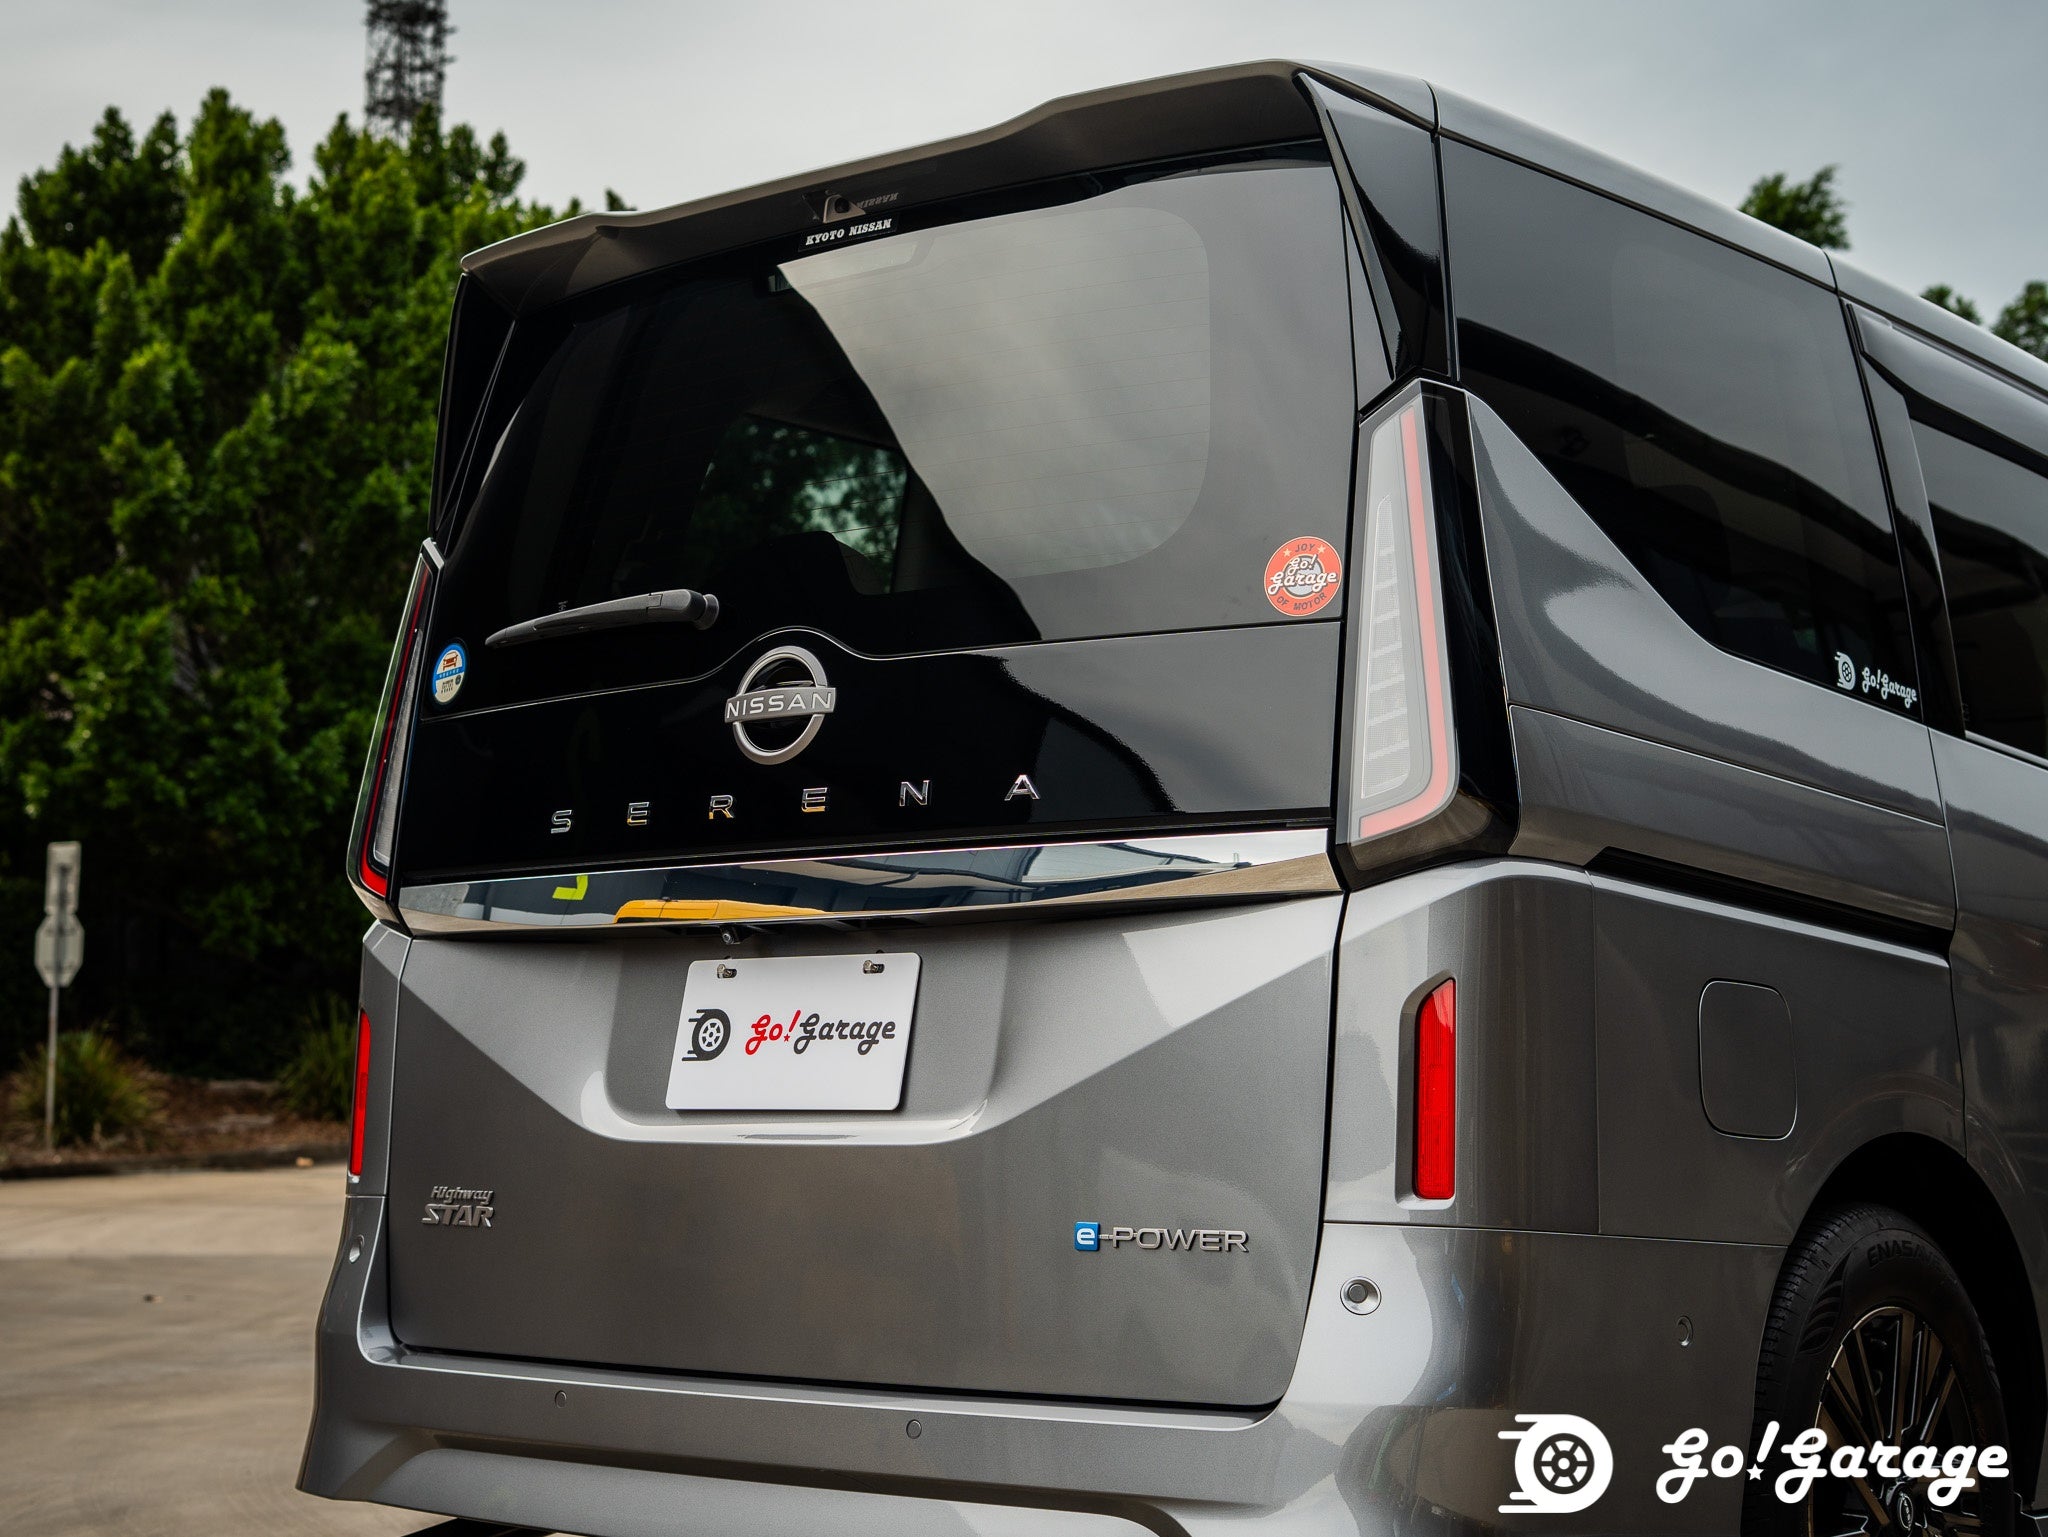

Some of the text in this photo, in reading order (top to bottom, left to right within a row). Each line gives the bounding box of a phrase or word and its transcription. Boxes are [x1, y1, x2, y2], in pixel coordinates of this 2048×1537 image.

[805, 218, 892, 246] KYOTO NISSAN
[1295, 543, 1315, 552] JOY
[1267, 571, 1337, 595] Garage
[1276, 592, 1327, 611] OF MOTOR
[726, 691, 833, 719] NISSAN
[550, 774, 1041, 834] SERENA
[430, 1185, 494, 1205] Highway
[421, 1203, 494, 1228] STAR
